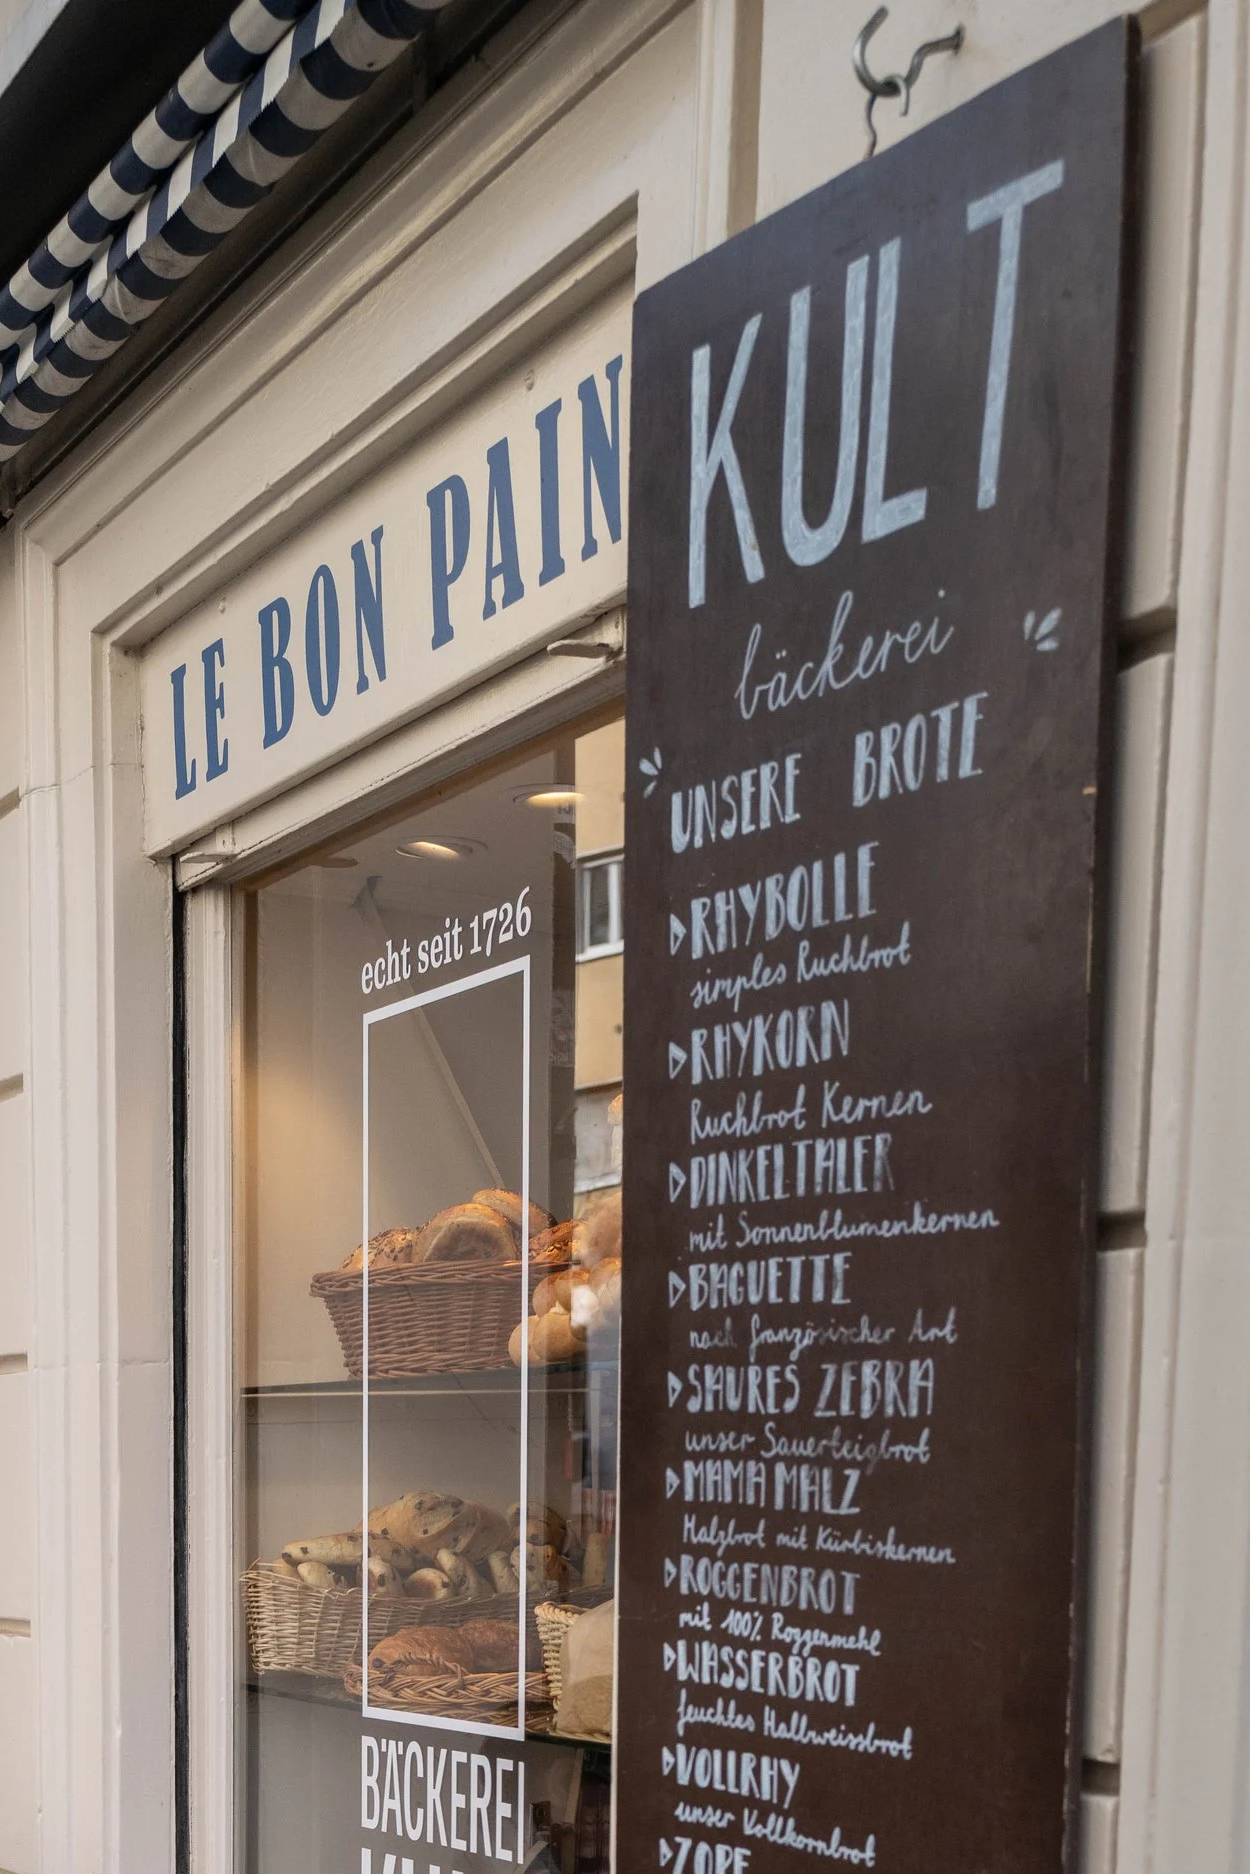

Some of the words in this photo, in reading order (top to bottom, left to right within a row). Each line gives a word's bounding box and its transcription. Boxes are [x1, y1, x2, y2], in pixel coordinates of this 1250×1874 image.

[688, 159, 1065, 609] KULT
[171, 638, 228, 800] LE
[258, 524, 387, 750] BON
[426, 354, 623, 652] PAIN
[734, 588, 954, 719] bäckerei
[670, 753, 802, 854] UNSERE
[852, 691, 989, 807] BROTE
[690, 841, 880, 959] RHYBOLLE
[361, 939, 411, 994] echt
[418, 916, 463, 973] seit
[470, 886, 532, 957] 1726
[690, 953, 787, 1012] simples
[796, 921, 912, 984] Ruchbrot
[690, 999, 850, 1085] RHYKORN
[690, 1084, 806, 1144] Ruchbrot
[821, 1081, 933, 1129] Kernen
[689, 1213, 728, 1252] mit
[737, 1202, 999, 1248] Sonnenblumenkernen
[689, 1252, 853, 1311] BAGUETTE
[689, 1318, 738, 1350] nach
[750, 1313, 895, 1362] französischer
[908, 1306, 958, 1344] Art
[687, 1364, 800, 1414] SAURES
[814, 1358, 935, 1419] ZEBRA
[685, 1430, 755, 1454] unser
[761, 1422, 931, 1475] Sauerteigbrot
[684, 1460, 767, 1508] MAMA
[774, 1461, 861, 1515] MALZ
[683, 1514, 766, 1558] Malzbrot
[776, 1524, 807, 1550] mit
[816, 1526, 956, 1566] Kürbiskernen
[679, 1554, 861, 1616] ROGGENBROT
[679, 1601, 712, 1631] mit
[720, 1609, 763, 1642] 100%
[771, 1612, 882, 1658] Roggenmehl
[676, 1639, 860, 1707] WASSERBROT
[676, 1688, 755, 1736] feuchtes
[763, 1705, 913, 1760] Halbweissbrot
[361, 1735, 525, 1865] BÄCKEREI
[675, 1743, 800, 1808] VOLLRHY
[675, 1800, 735, 1829] unser
[743, 1807, 876, 1868] Vollkornbrot
